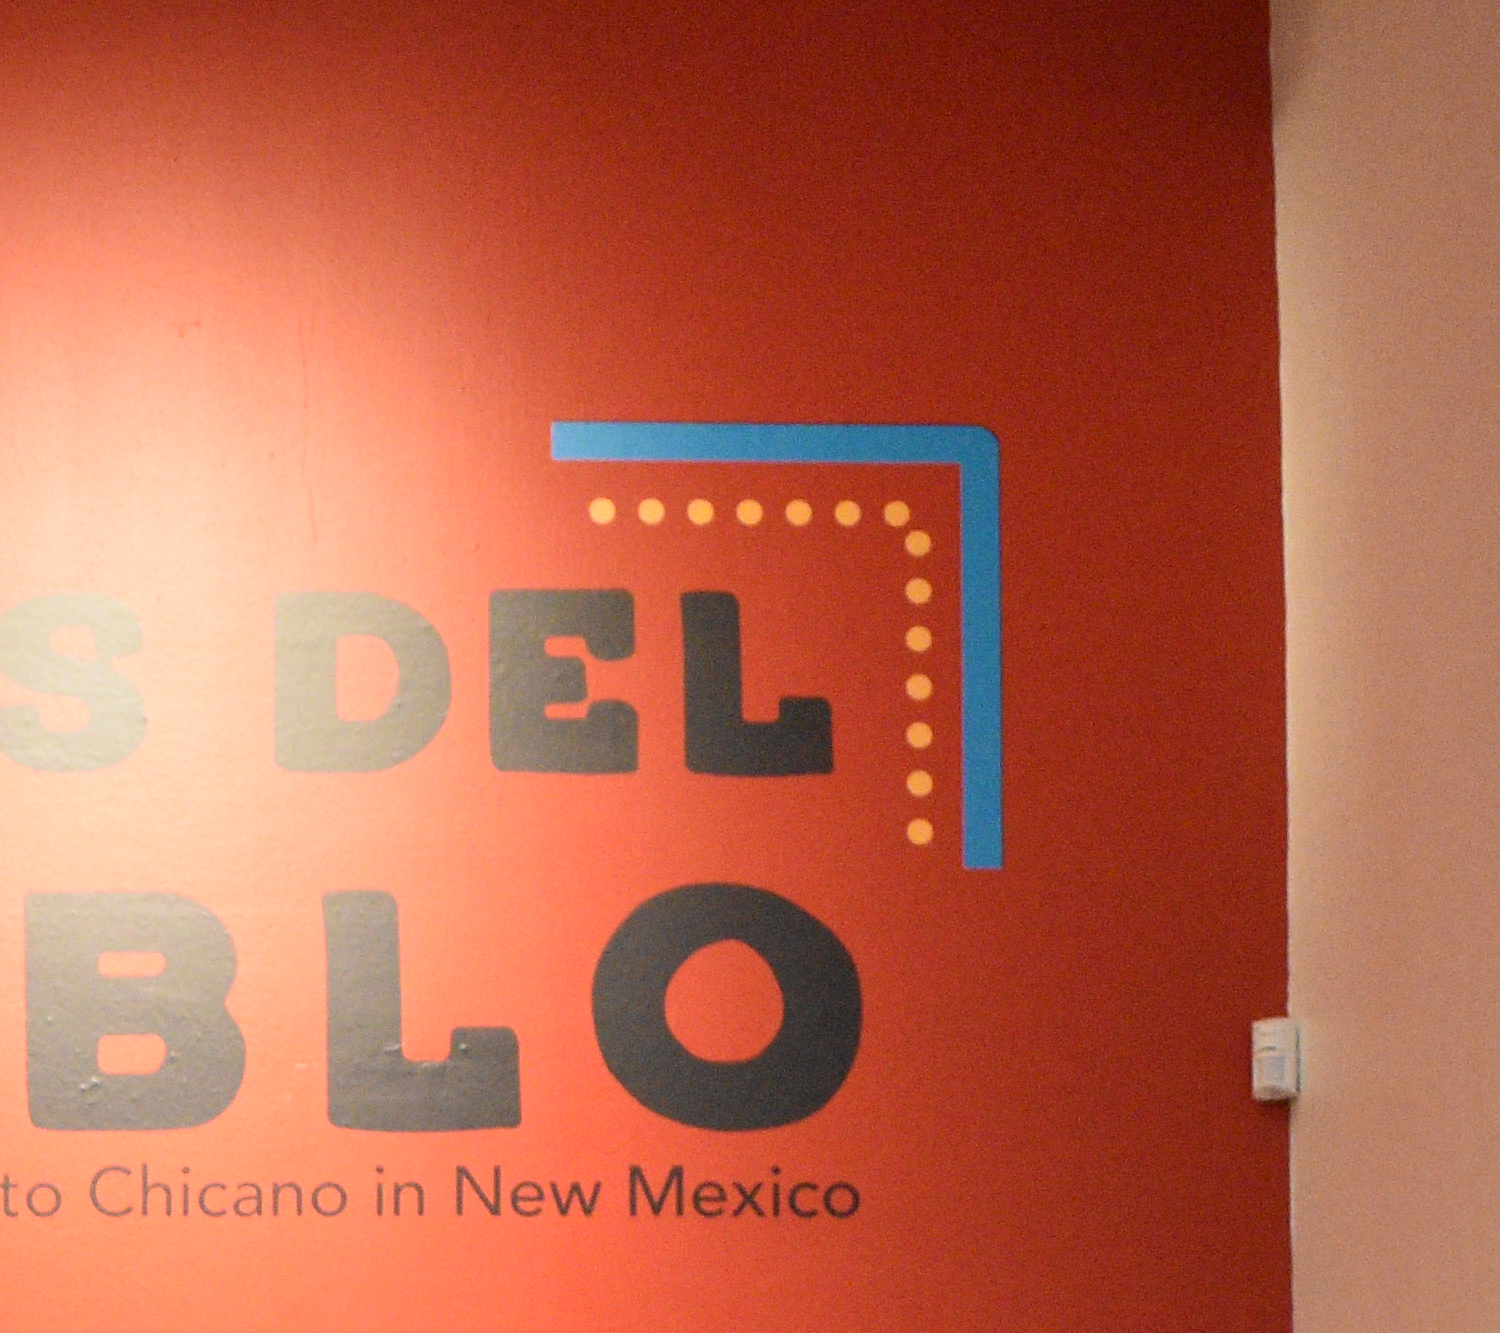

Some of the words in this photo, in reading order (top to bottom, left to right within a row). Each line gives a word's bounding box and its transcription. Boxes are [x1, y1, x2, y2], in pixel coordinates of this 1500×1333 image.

[274, 588, 834, 778] DEL
[90, 1163, 347, 1217] Chicano
[376, 1165, 424, 1217] in
[456, 1165, 603, 1217] New
[629, 1164, 862, 1218] Mexico
